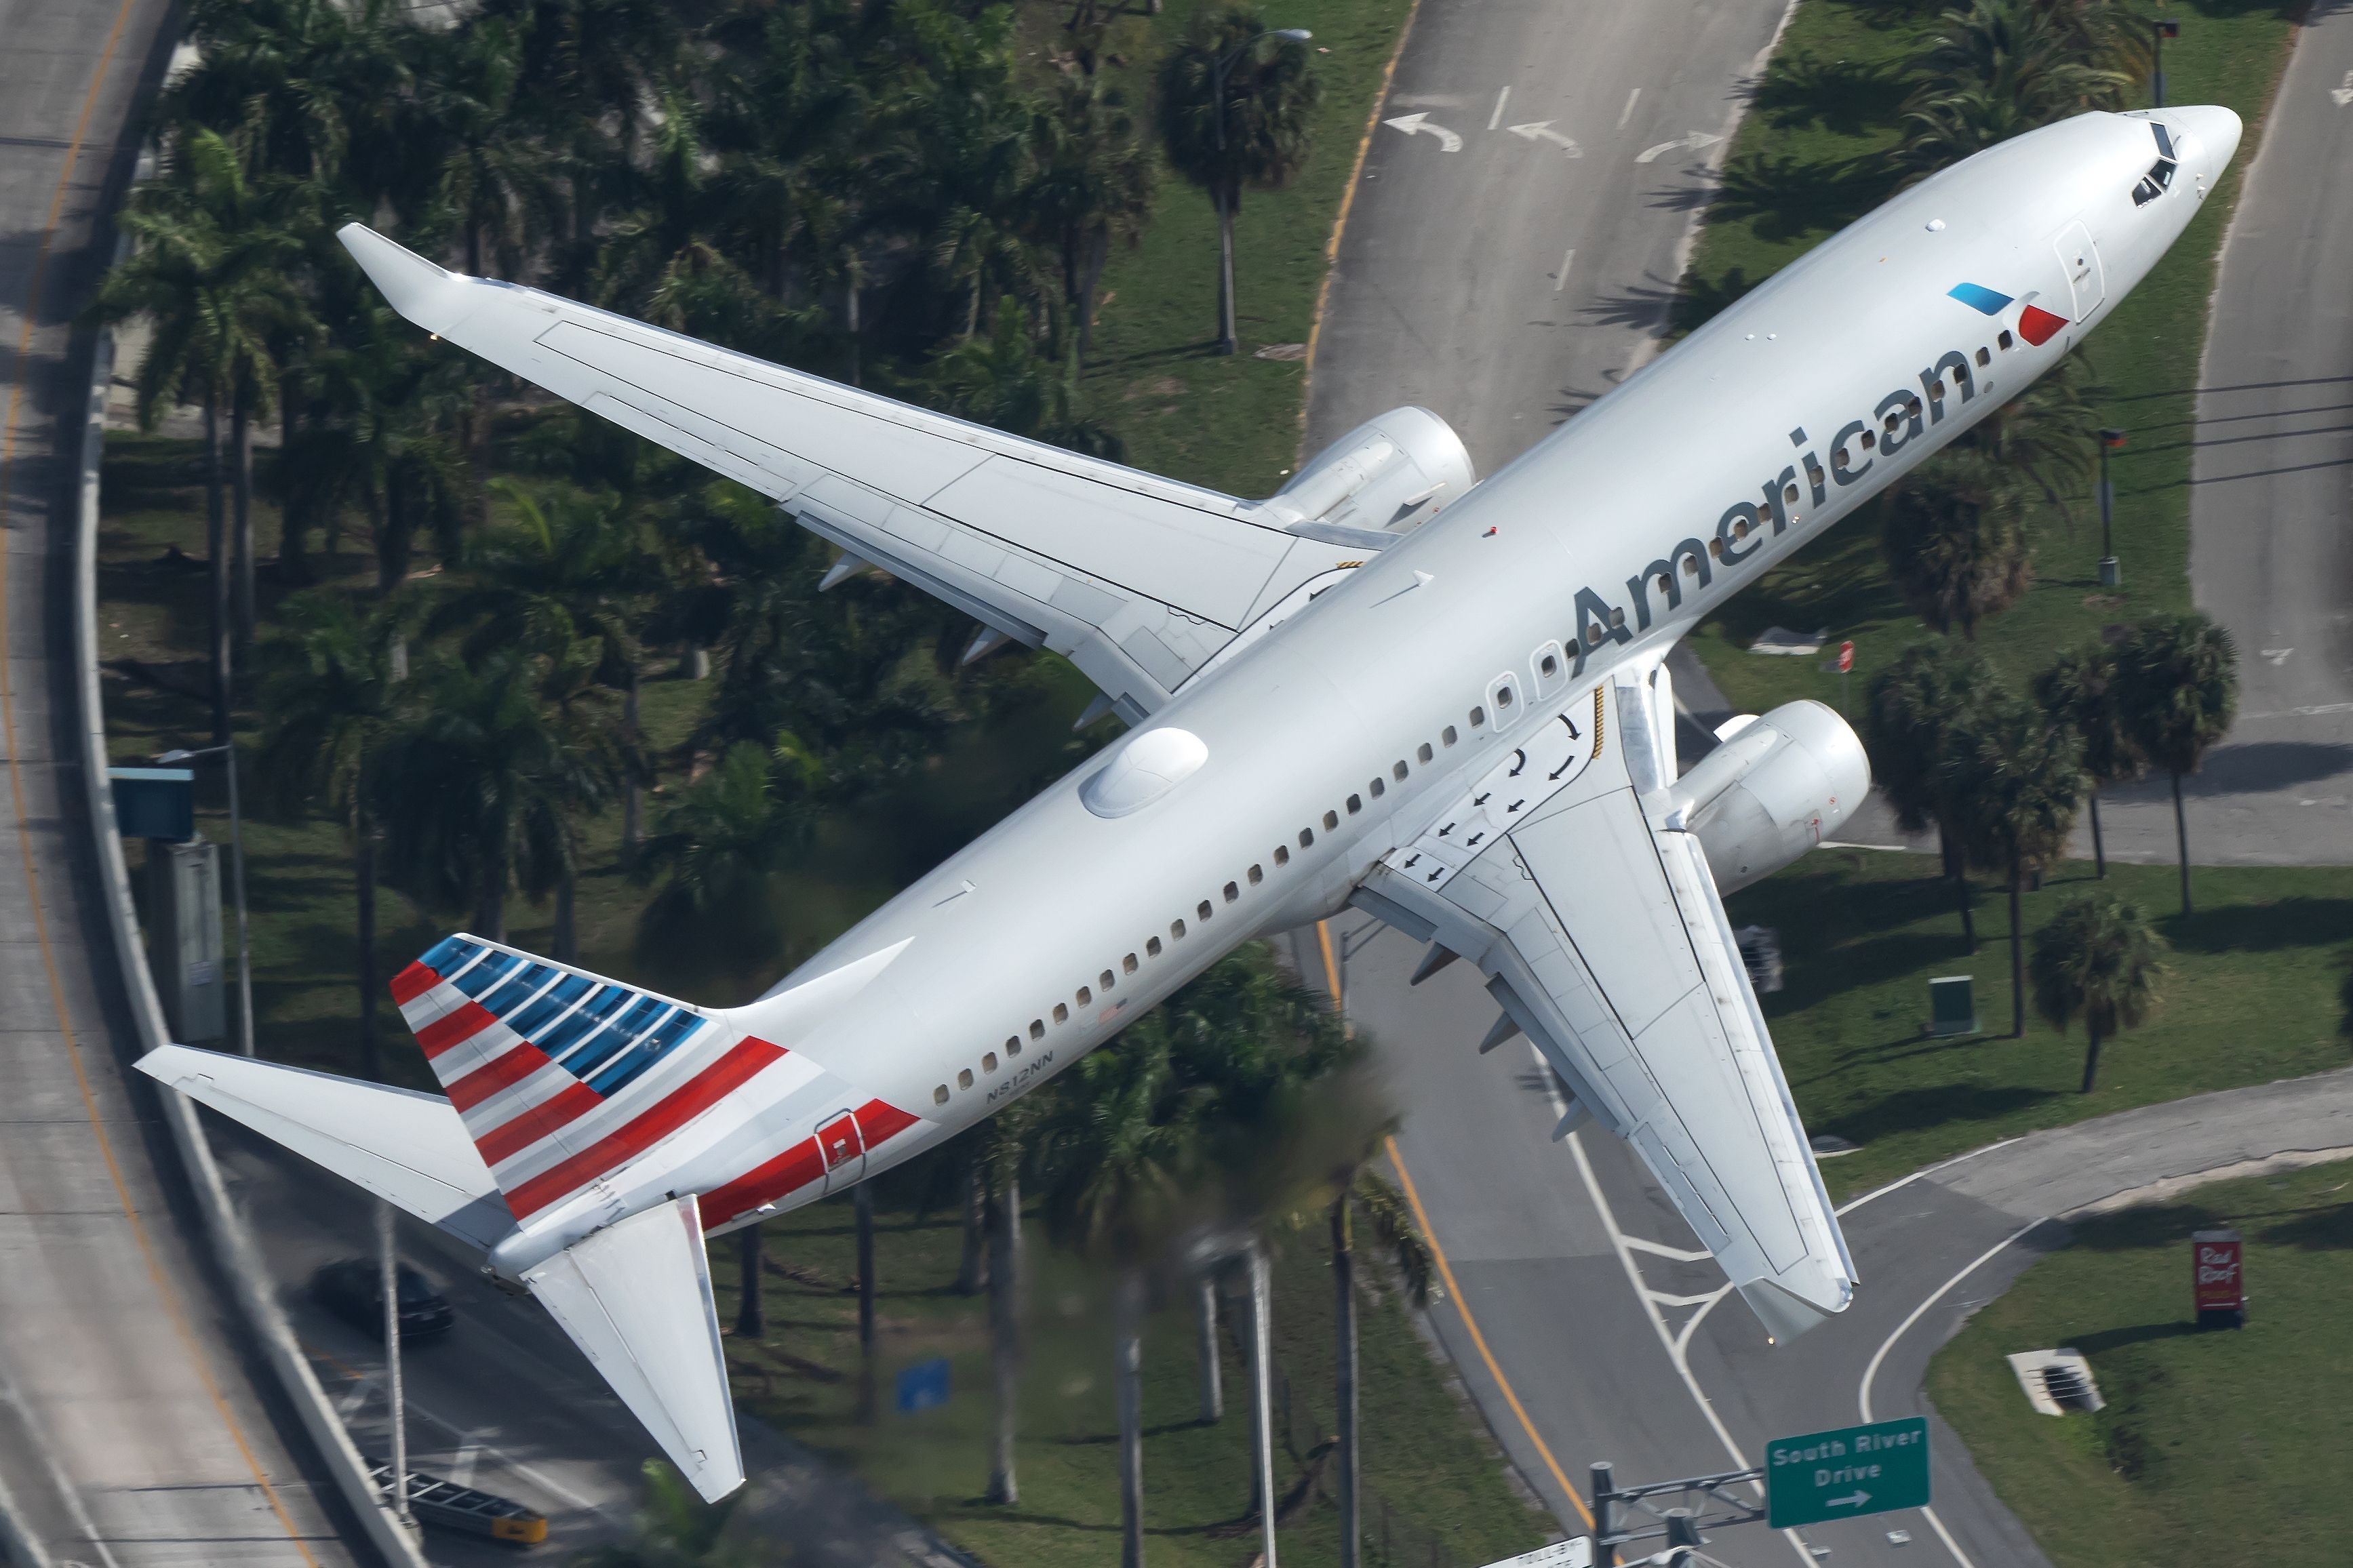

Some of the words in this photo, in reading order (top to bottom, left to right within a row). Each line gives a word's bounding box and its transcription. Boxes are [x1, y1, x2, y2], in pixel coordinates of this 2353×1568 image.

[1570, 350, 1974, 681] American
[2198, 1263, 2240, 1285] Roof
[1772, 1440, 1846, 1466] South
[1855, 1428, 1922, 1454] River
[1814, 1462, 1882, 1487] Drive
